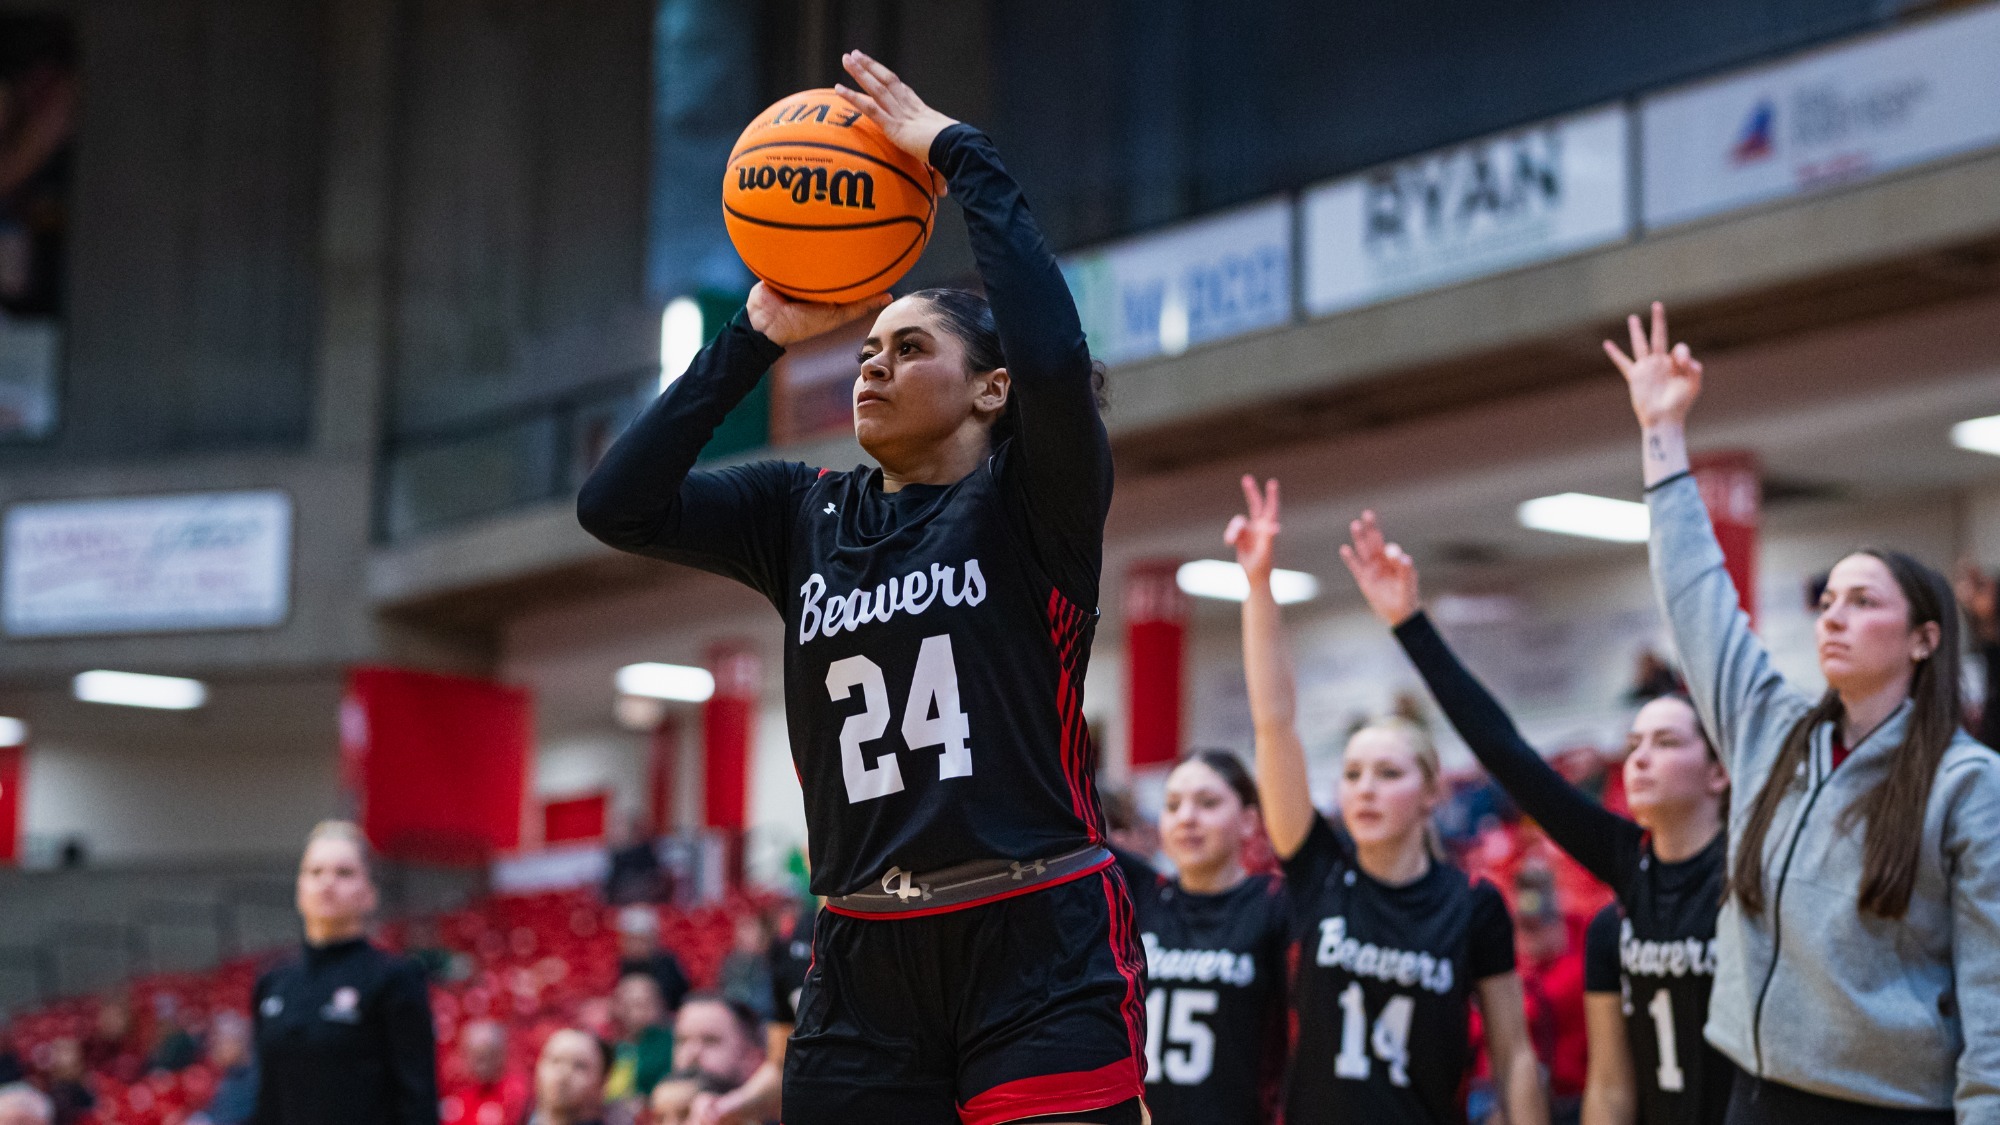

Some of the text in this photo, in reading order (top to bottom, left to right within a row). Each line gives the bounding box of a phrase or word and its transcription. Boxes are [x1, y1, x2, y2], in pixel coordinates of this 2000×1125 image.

[738, 165, 876, 211] Wilson
[800, 558, 987, 645] Beavers
[825, 633, 973, 805] 24
[1316, 915, 1454, 994] Beavers
[1145, 988, 1219, 1086] 15
[1334, 981, 1415, 1088] 14
